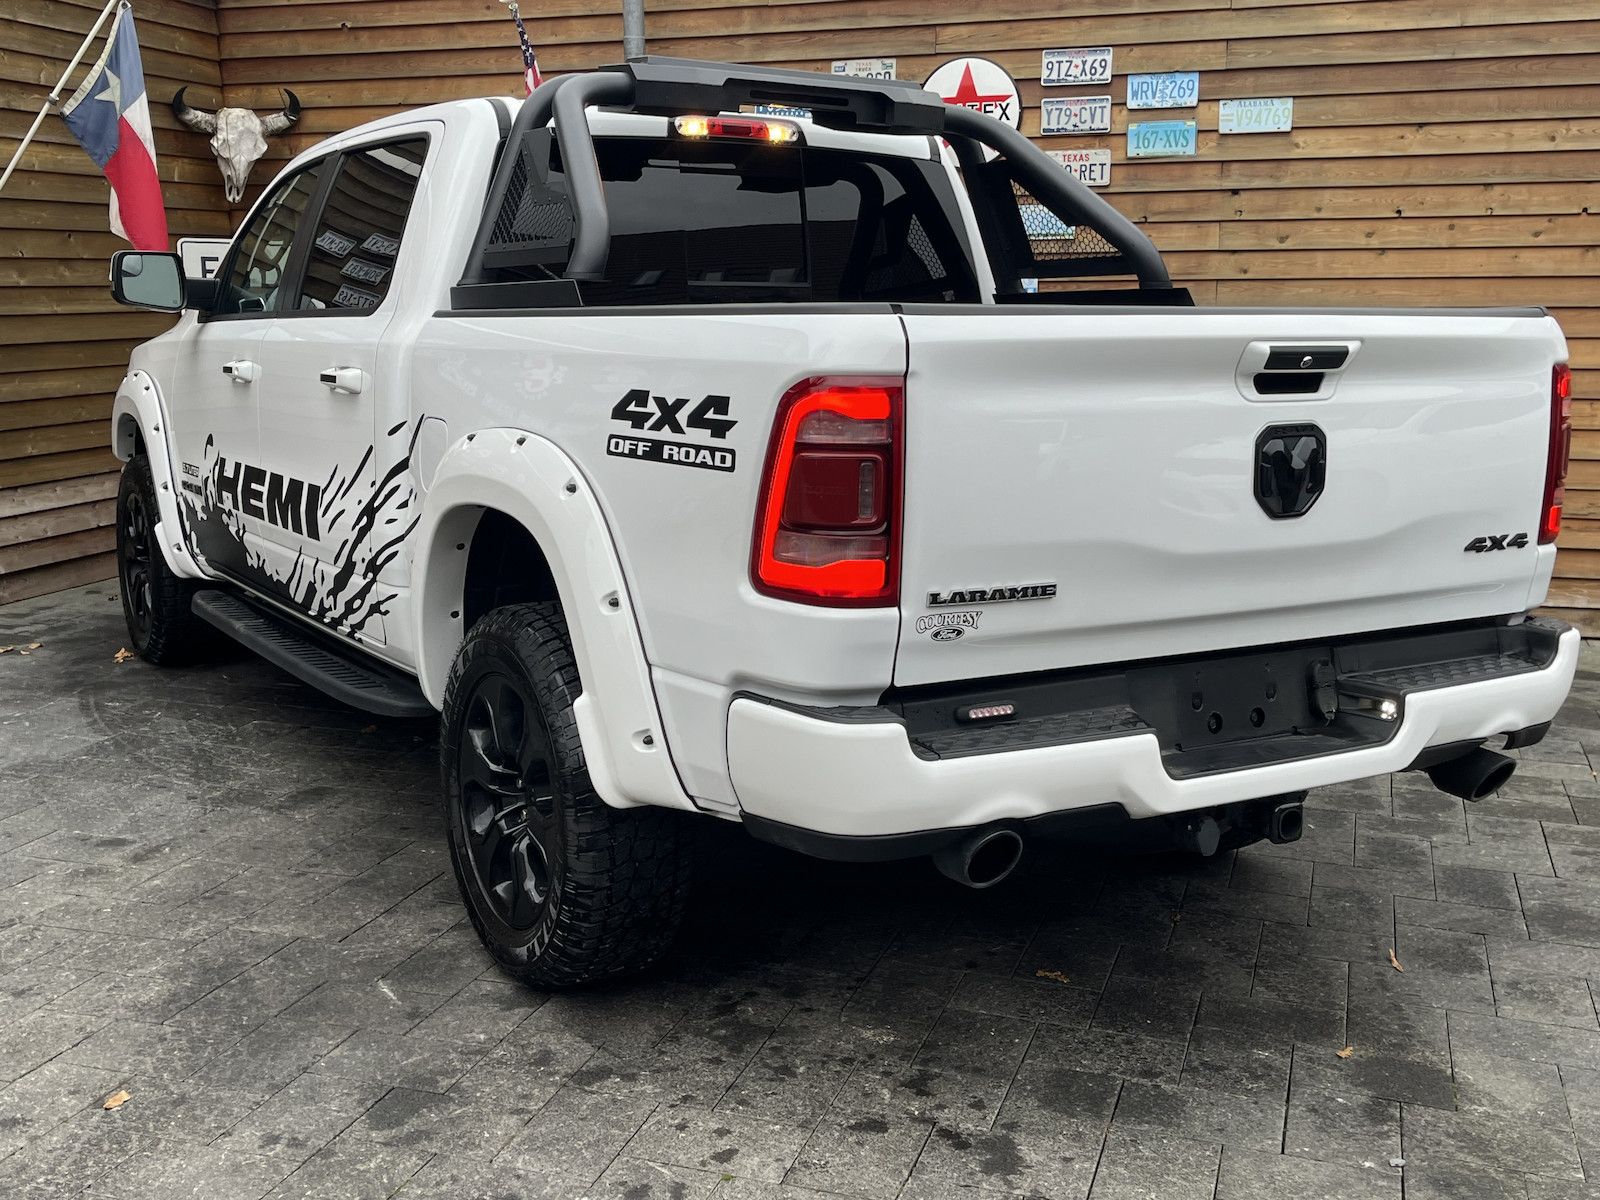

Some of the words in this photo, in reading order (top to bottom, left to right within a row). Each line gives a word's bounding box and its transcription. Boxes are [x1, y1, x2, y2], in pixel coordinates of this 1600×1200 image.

[1062, 153, 1090, 162] TEXAS
[609, 438, 652, 456] OFF
[662, 444, 733, 468] ROAD
[216, 456, 321, 542] HEMI
[927, 582, 1057, 607] LARAMIE
[915, 610, 983, 634] COURTESY
[935, 629, 959, 640] Ford
